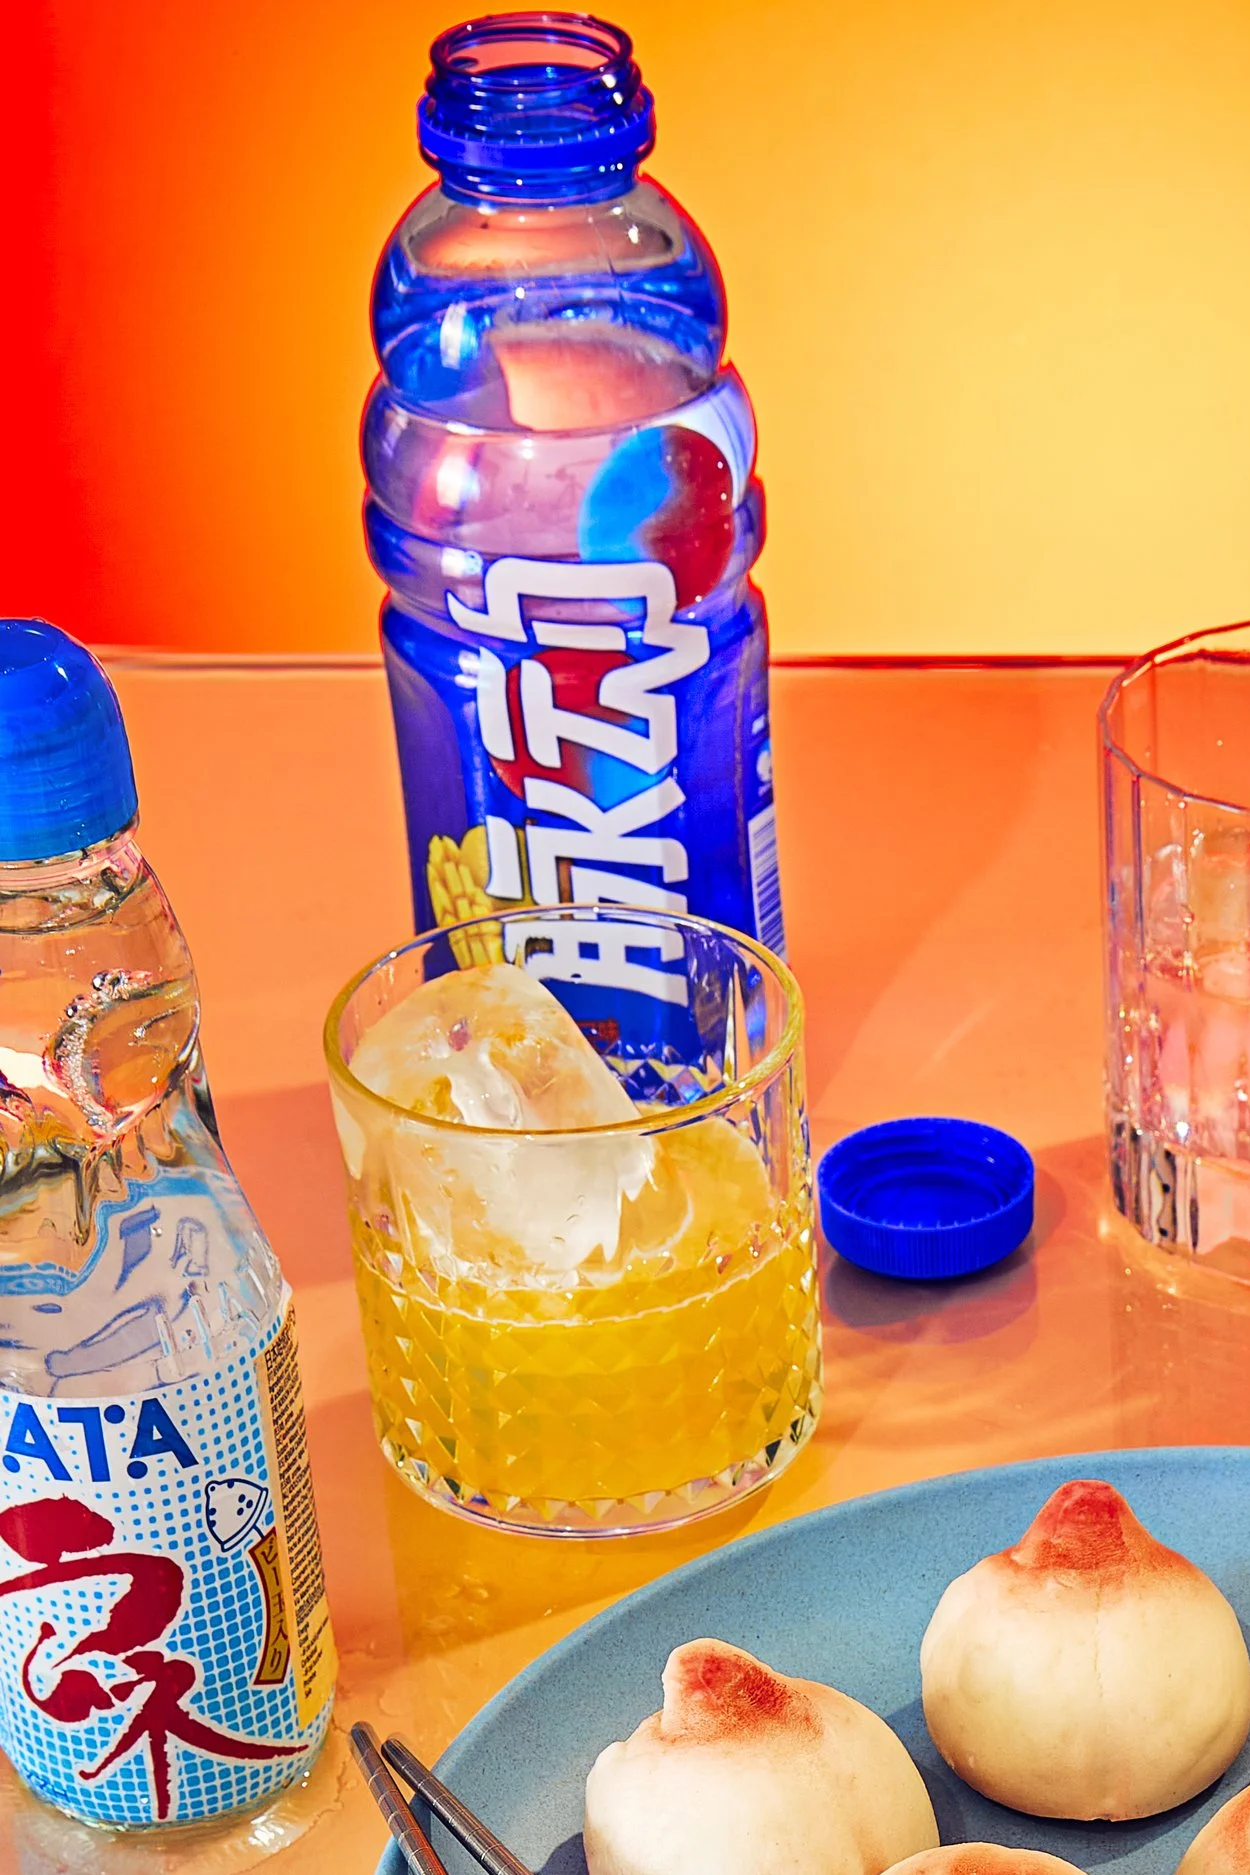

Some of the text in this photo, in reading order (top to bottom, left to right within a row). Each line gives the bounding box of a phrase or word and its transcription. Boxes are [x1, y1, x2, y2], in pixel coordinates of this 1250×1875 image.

[448, 556, 710, 1007] 脉动
[259, 1537, 290, 1675] ビー玉入り
